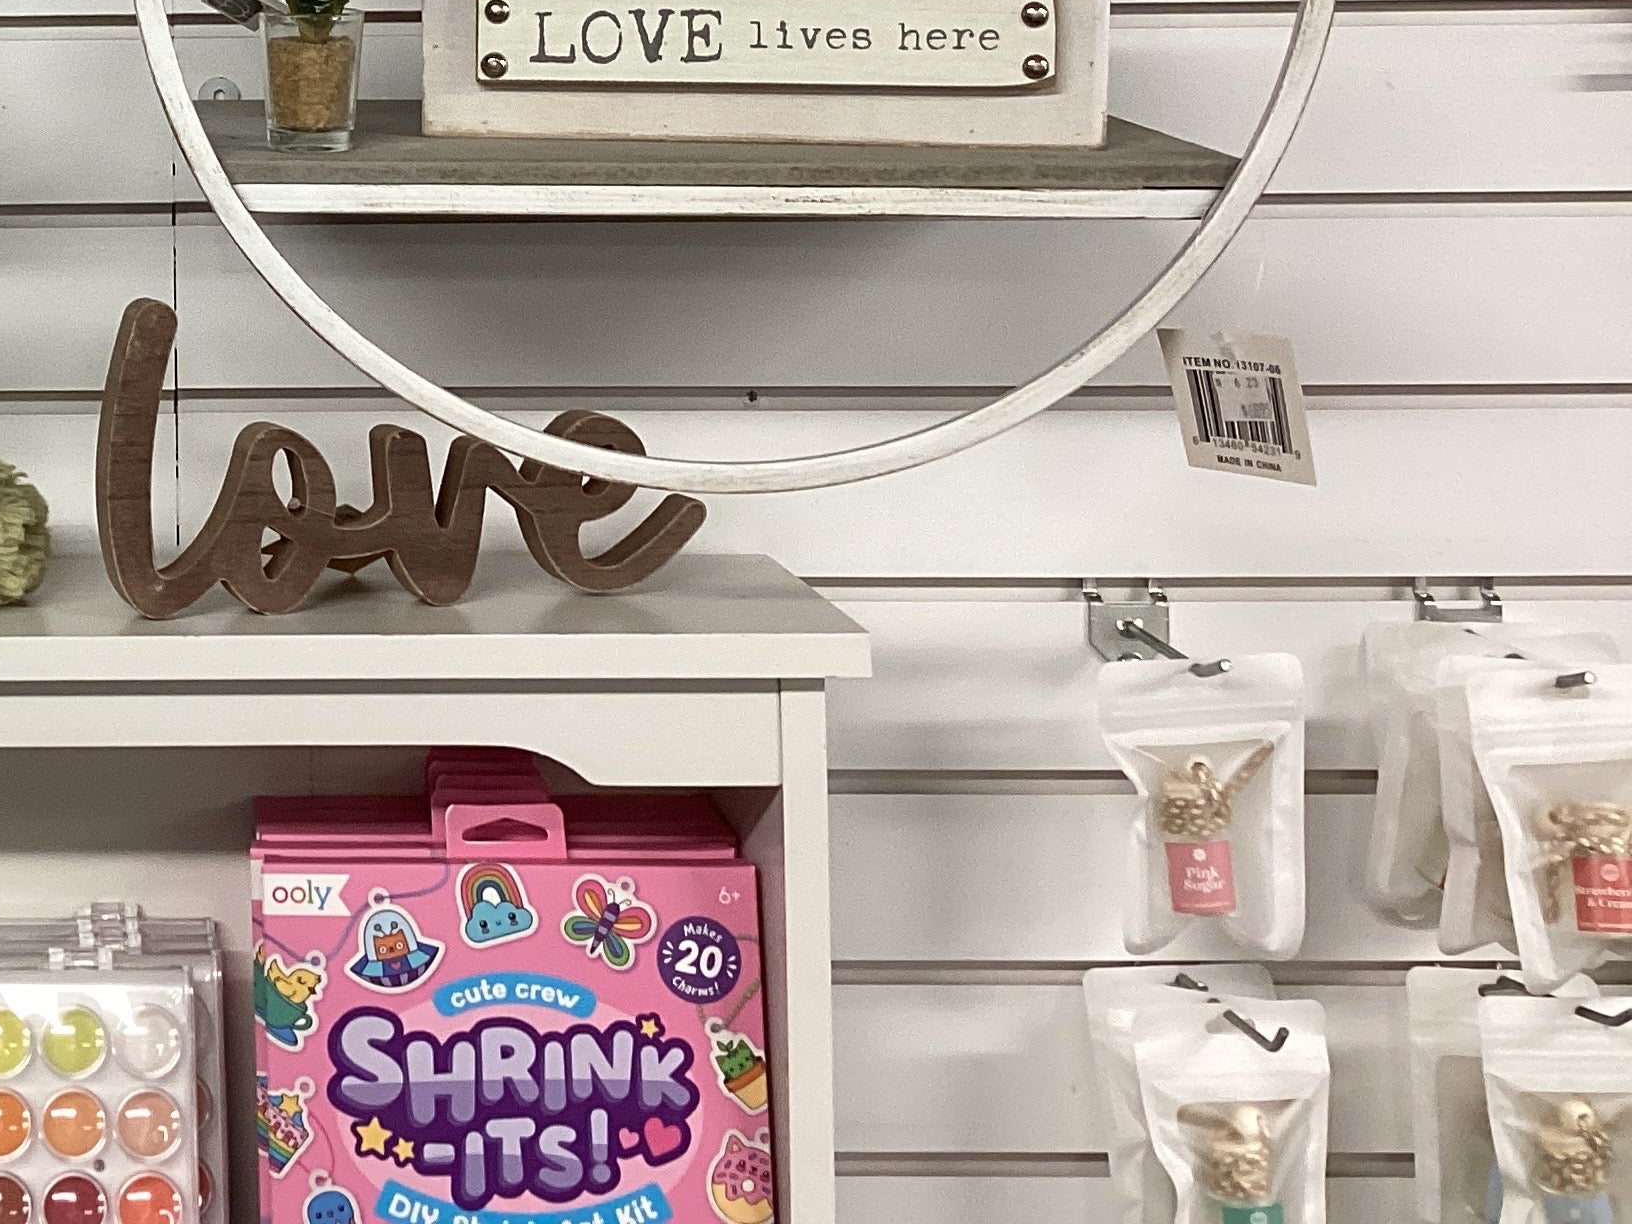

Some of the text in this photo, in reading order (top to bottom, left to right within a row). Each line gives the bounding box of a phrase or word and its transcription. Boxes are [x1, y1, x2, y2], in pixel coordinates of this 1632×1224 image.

[529, 9, 1001, 65] LOVE lives here
[1183, 356, 1211, 367] ITEM
[96, 297, 706, 620] love
[1217, 455, 1283, 472] MADE IN CHINA
[272, 879, 333, 911] ooly
[718, 886, 741, 905] 6+
[683, 922, 723, 943] Makes
[674, 939, 723, 979] 20
[450, 979, 580, 1009] cute crew
[672, 976, 721, 997] Charms!
[339, 1013, 692, 1126] SHRINK
[388, 1192, 658, 1224] DIY Kit
